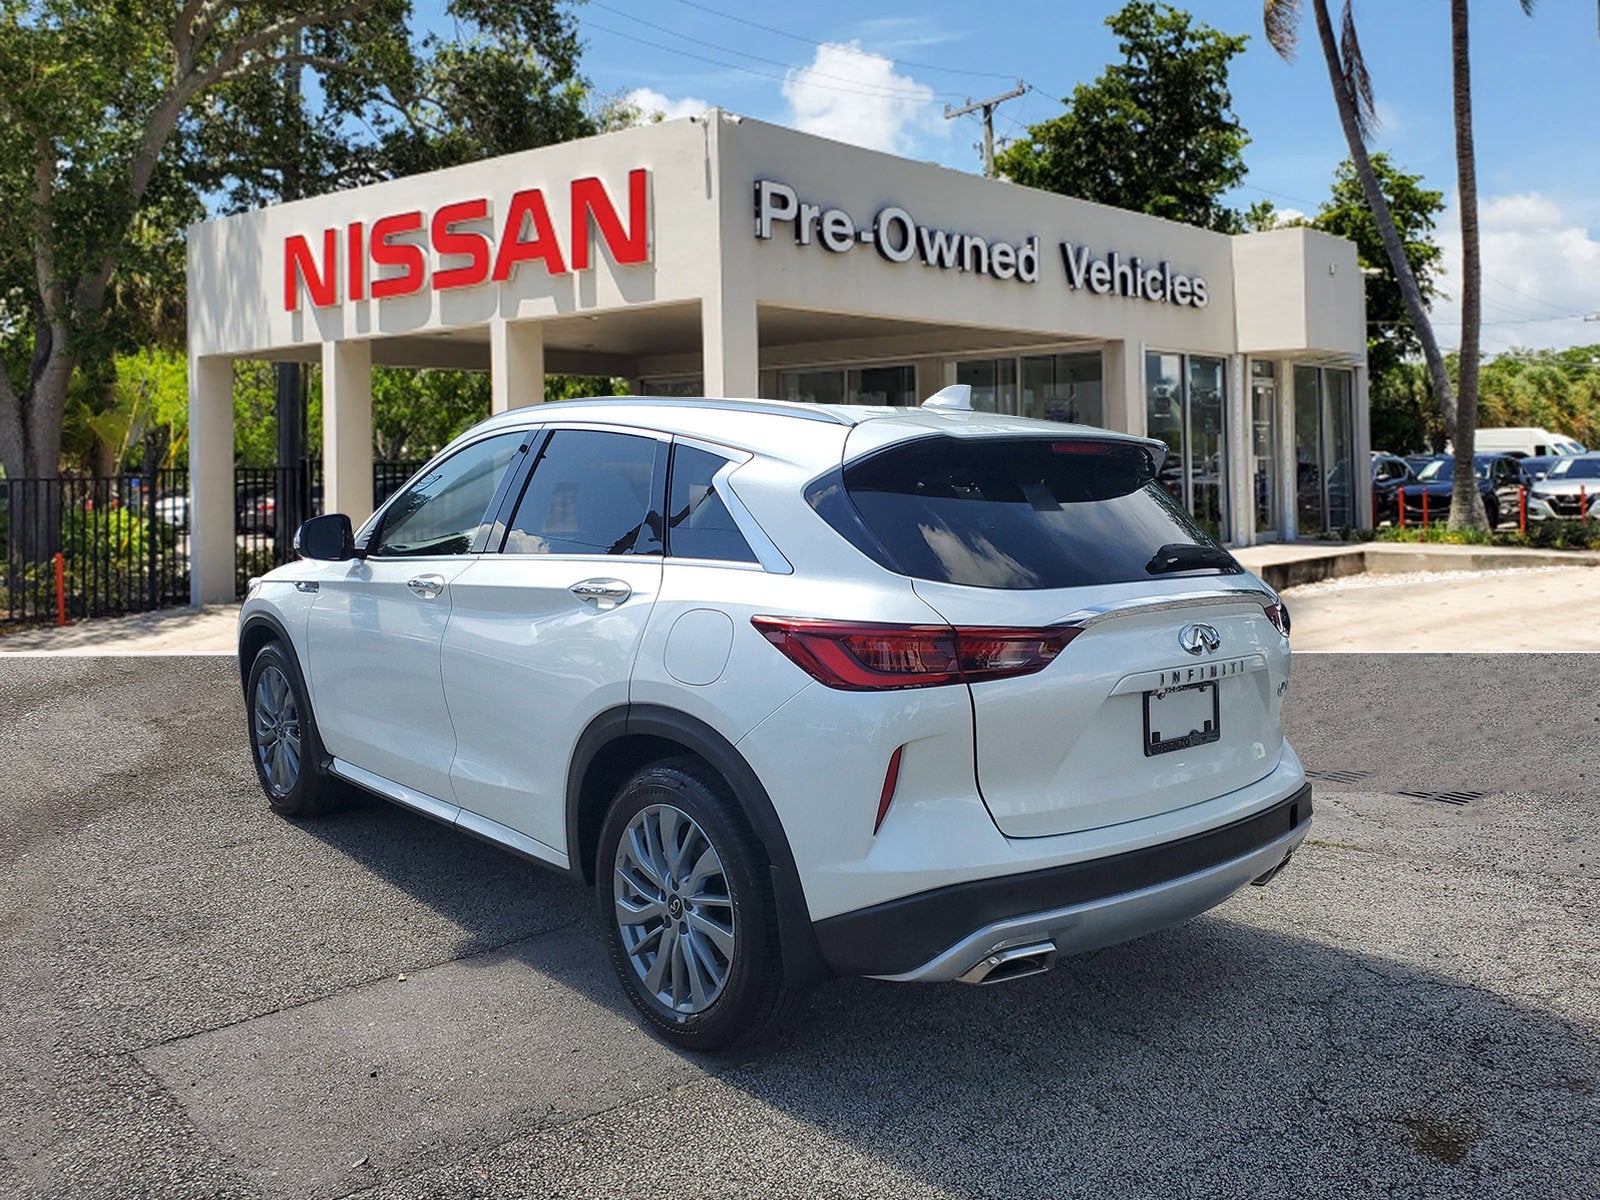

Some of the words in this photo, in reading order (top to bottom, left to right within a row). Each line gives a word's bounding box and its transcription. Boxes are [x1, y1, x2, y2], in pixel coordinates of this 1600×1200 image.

[284, 169, 648, 311] NISSAN
[755, 180, 1039, 284] Pre-Owned
[1060, 242, 1208, 308] Vehicles
[1160, 660, 1245, 686] INFINITI
